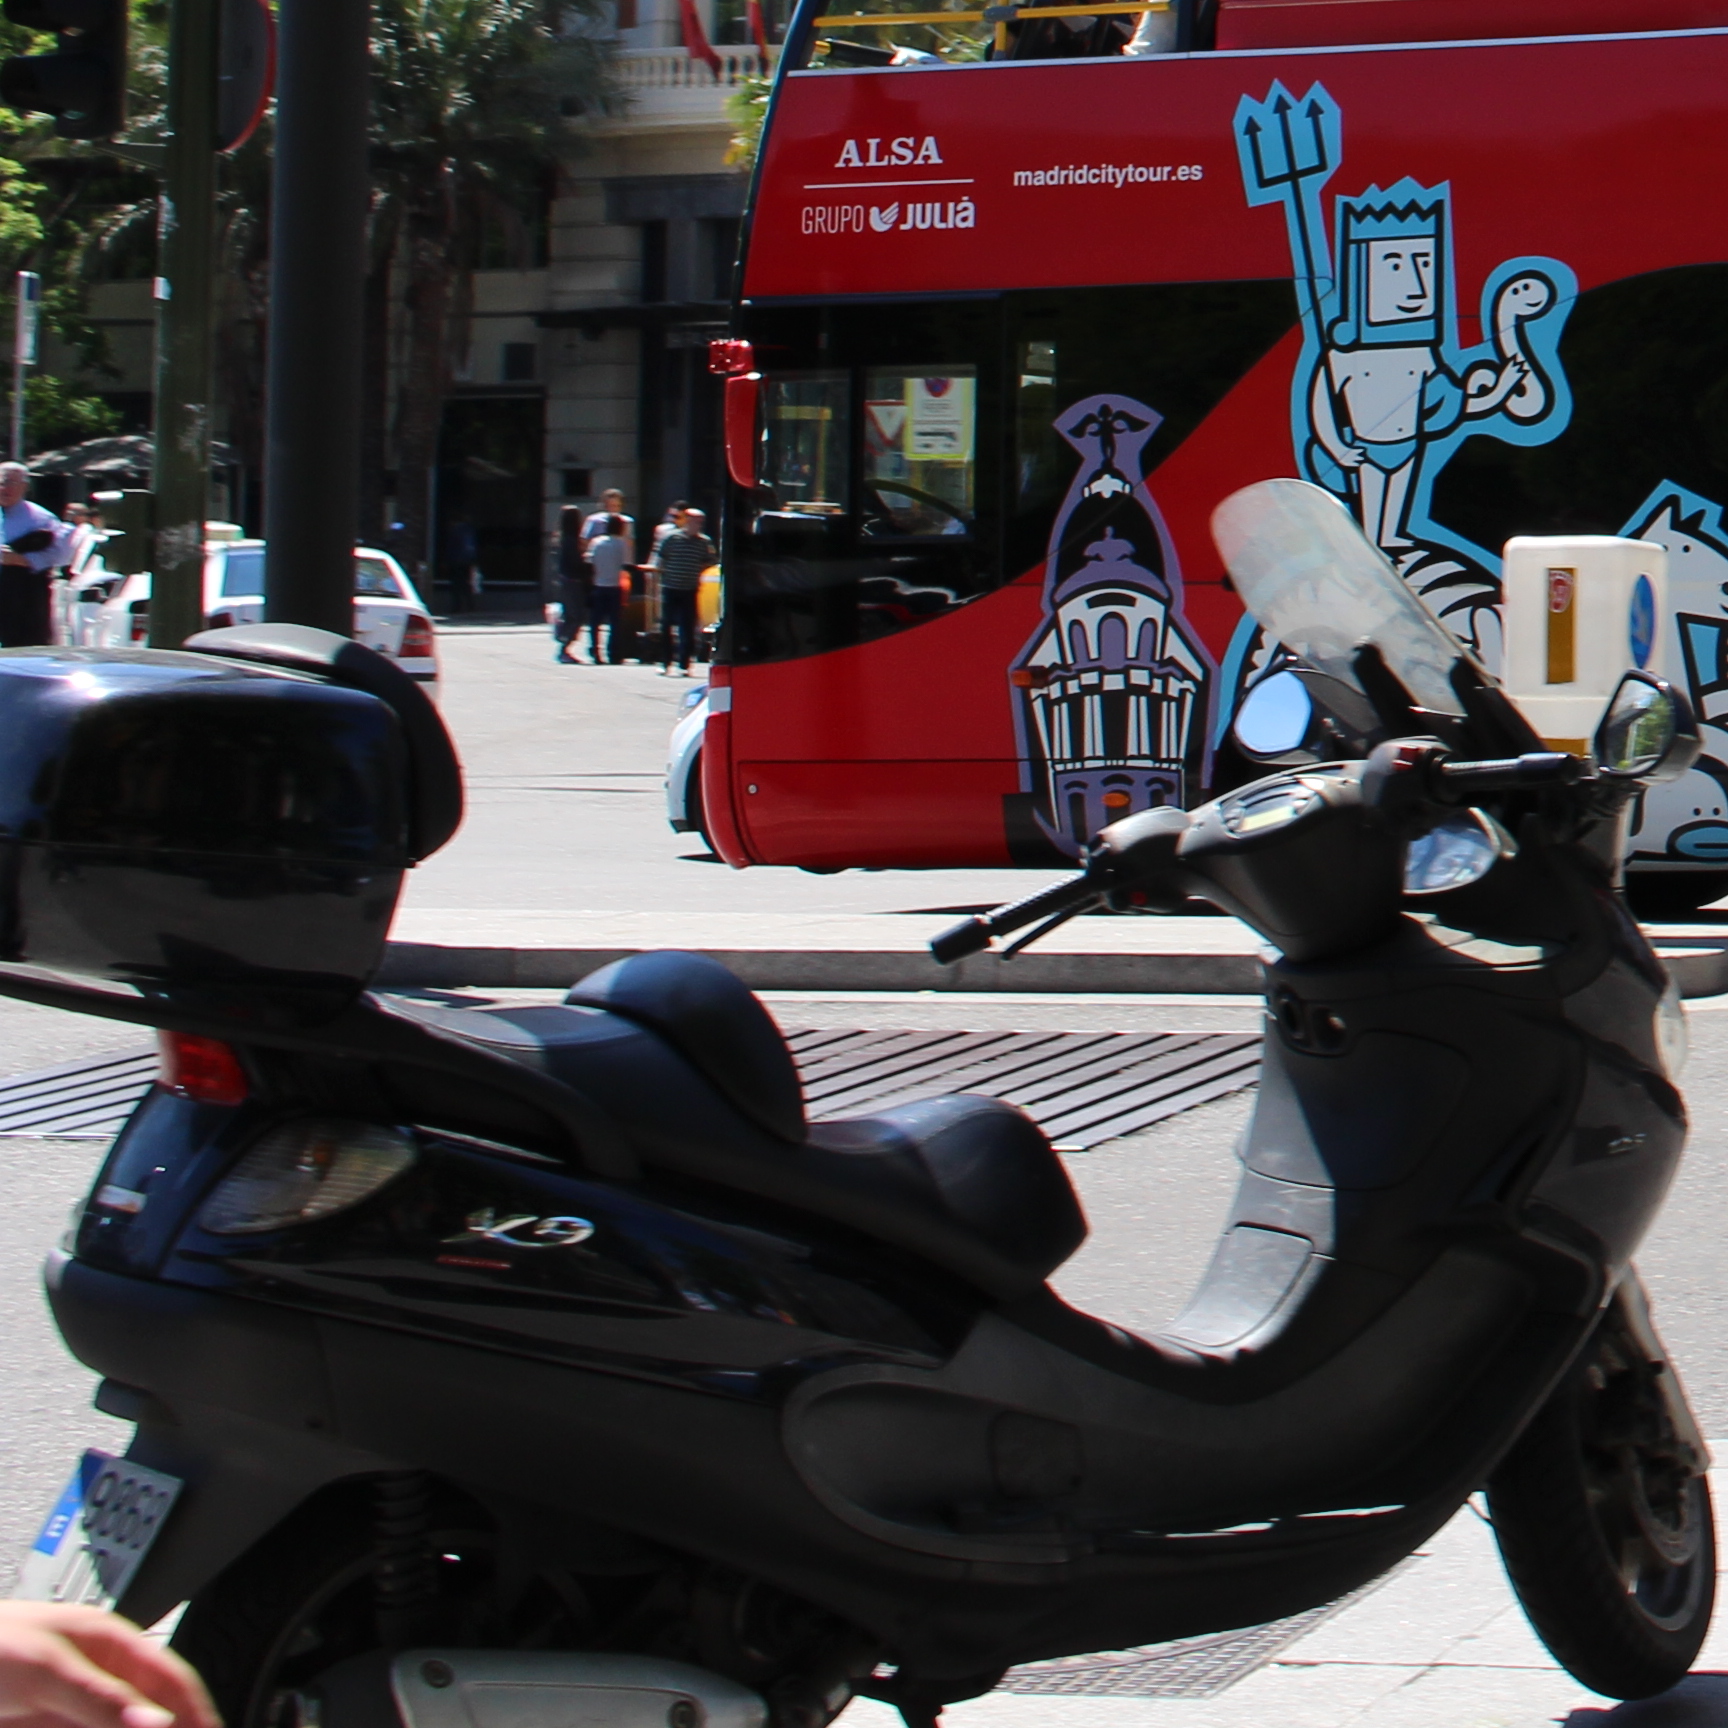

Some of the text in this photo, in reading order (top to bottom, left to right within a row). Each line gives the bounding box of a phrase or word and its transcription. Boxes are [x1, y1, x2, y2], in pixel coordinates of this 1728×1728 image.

[834, 135, 943, 169] ALSA
[1013, 163, 1203, 189] madridcitytour.es
[801, 204, 864, 235] GRUPO
